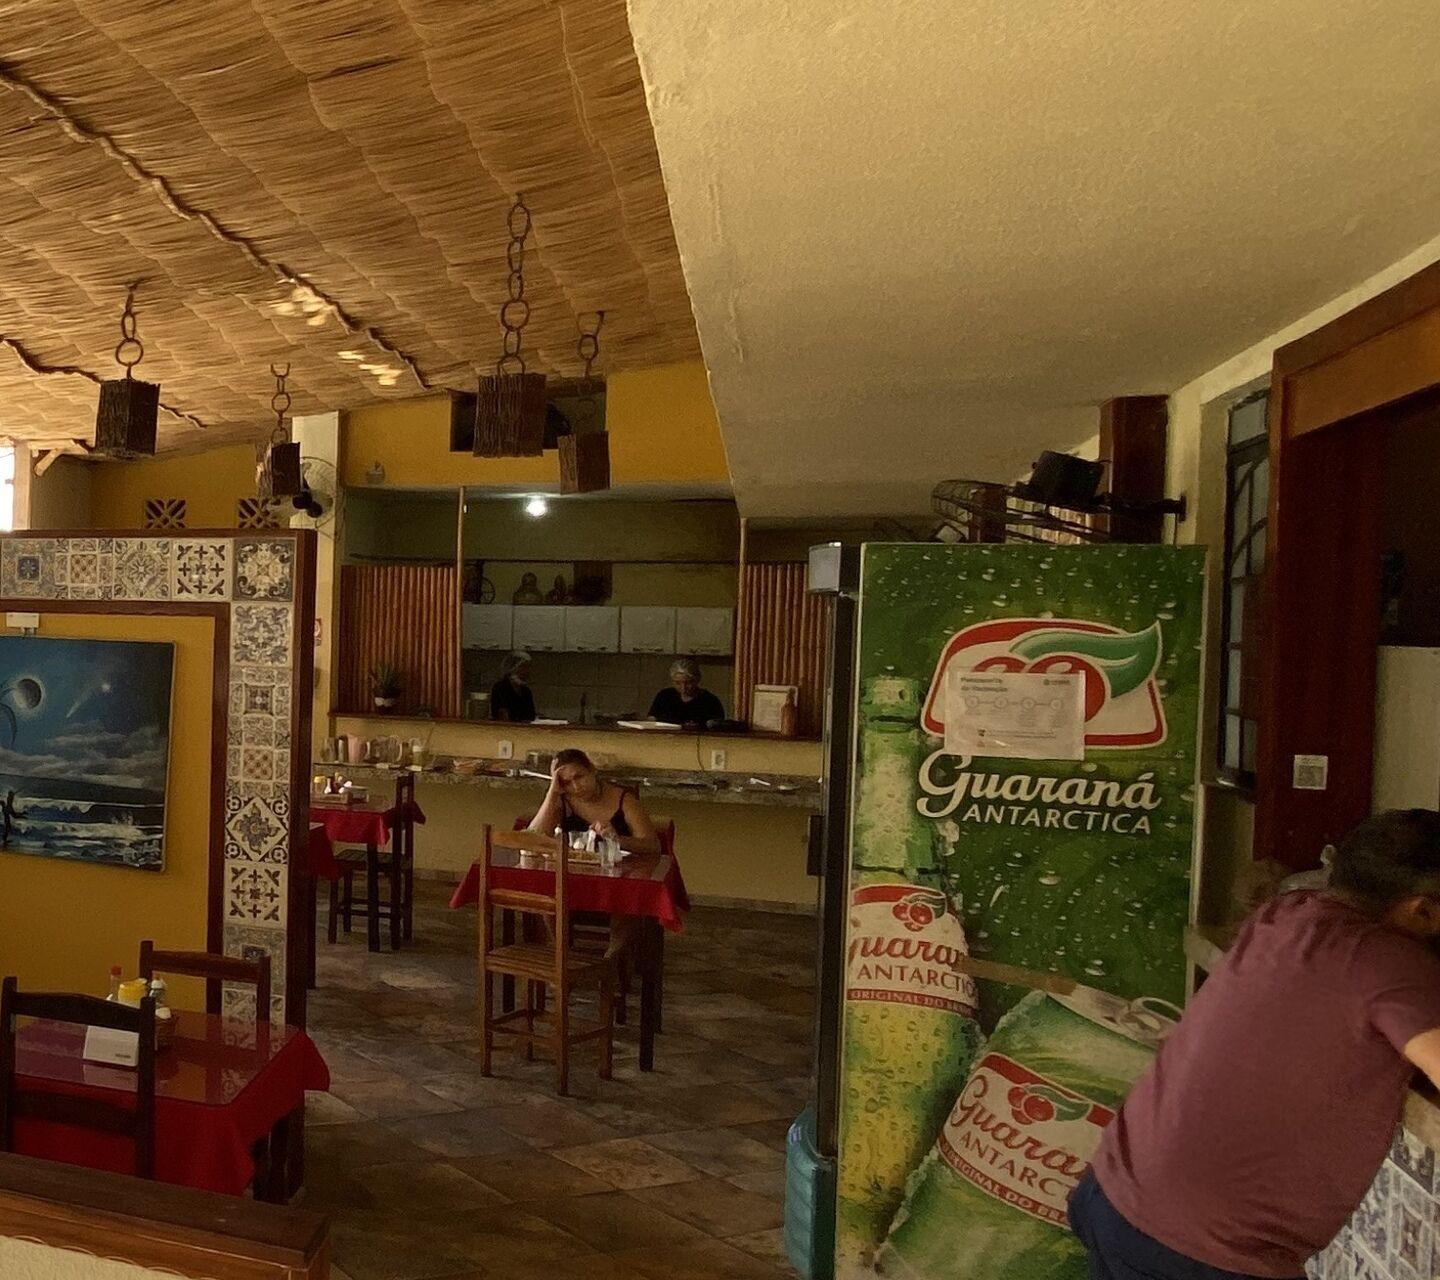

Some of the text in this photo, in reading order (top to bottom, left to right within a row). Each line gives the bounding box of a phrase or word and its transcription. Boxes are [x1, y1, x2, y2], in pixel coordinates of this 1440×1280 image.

[916, 750, 1162, 818] Guaraná
[962, 803, 1152, 835] ANTARCTICA
[950, 1074, 1086, 1180] Guara
[942, 1142, 1005, 1197] ORIGINAL
[1005, 1190, 1034, 1210] DO
